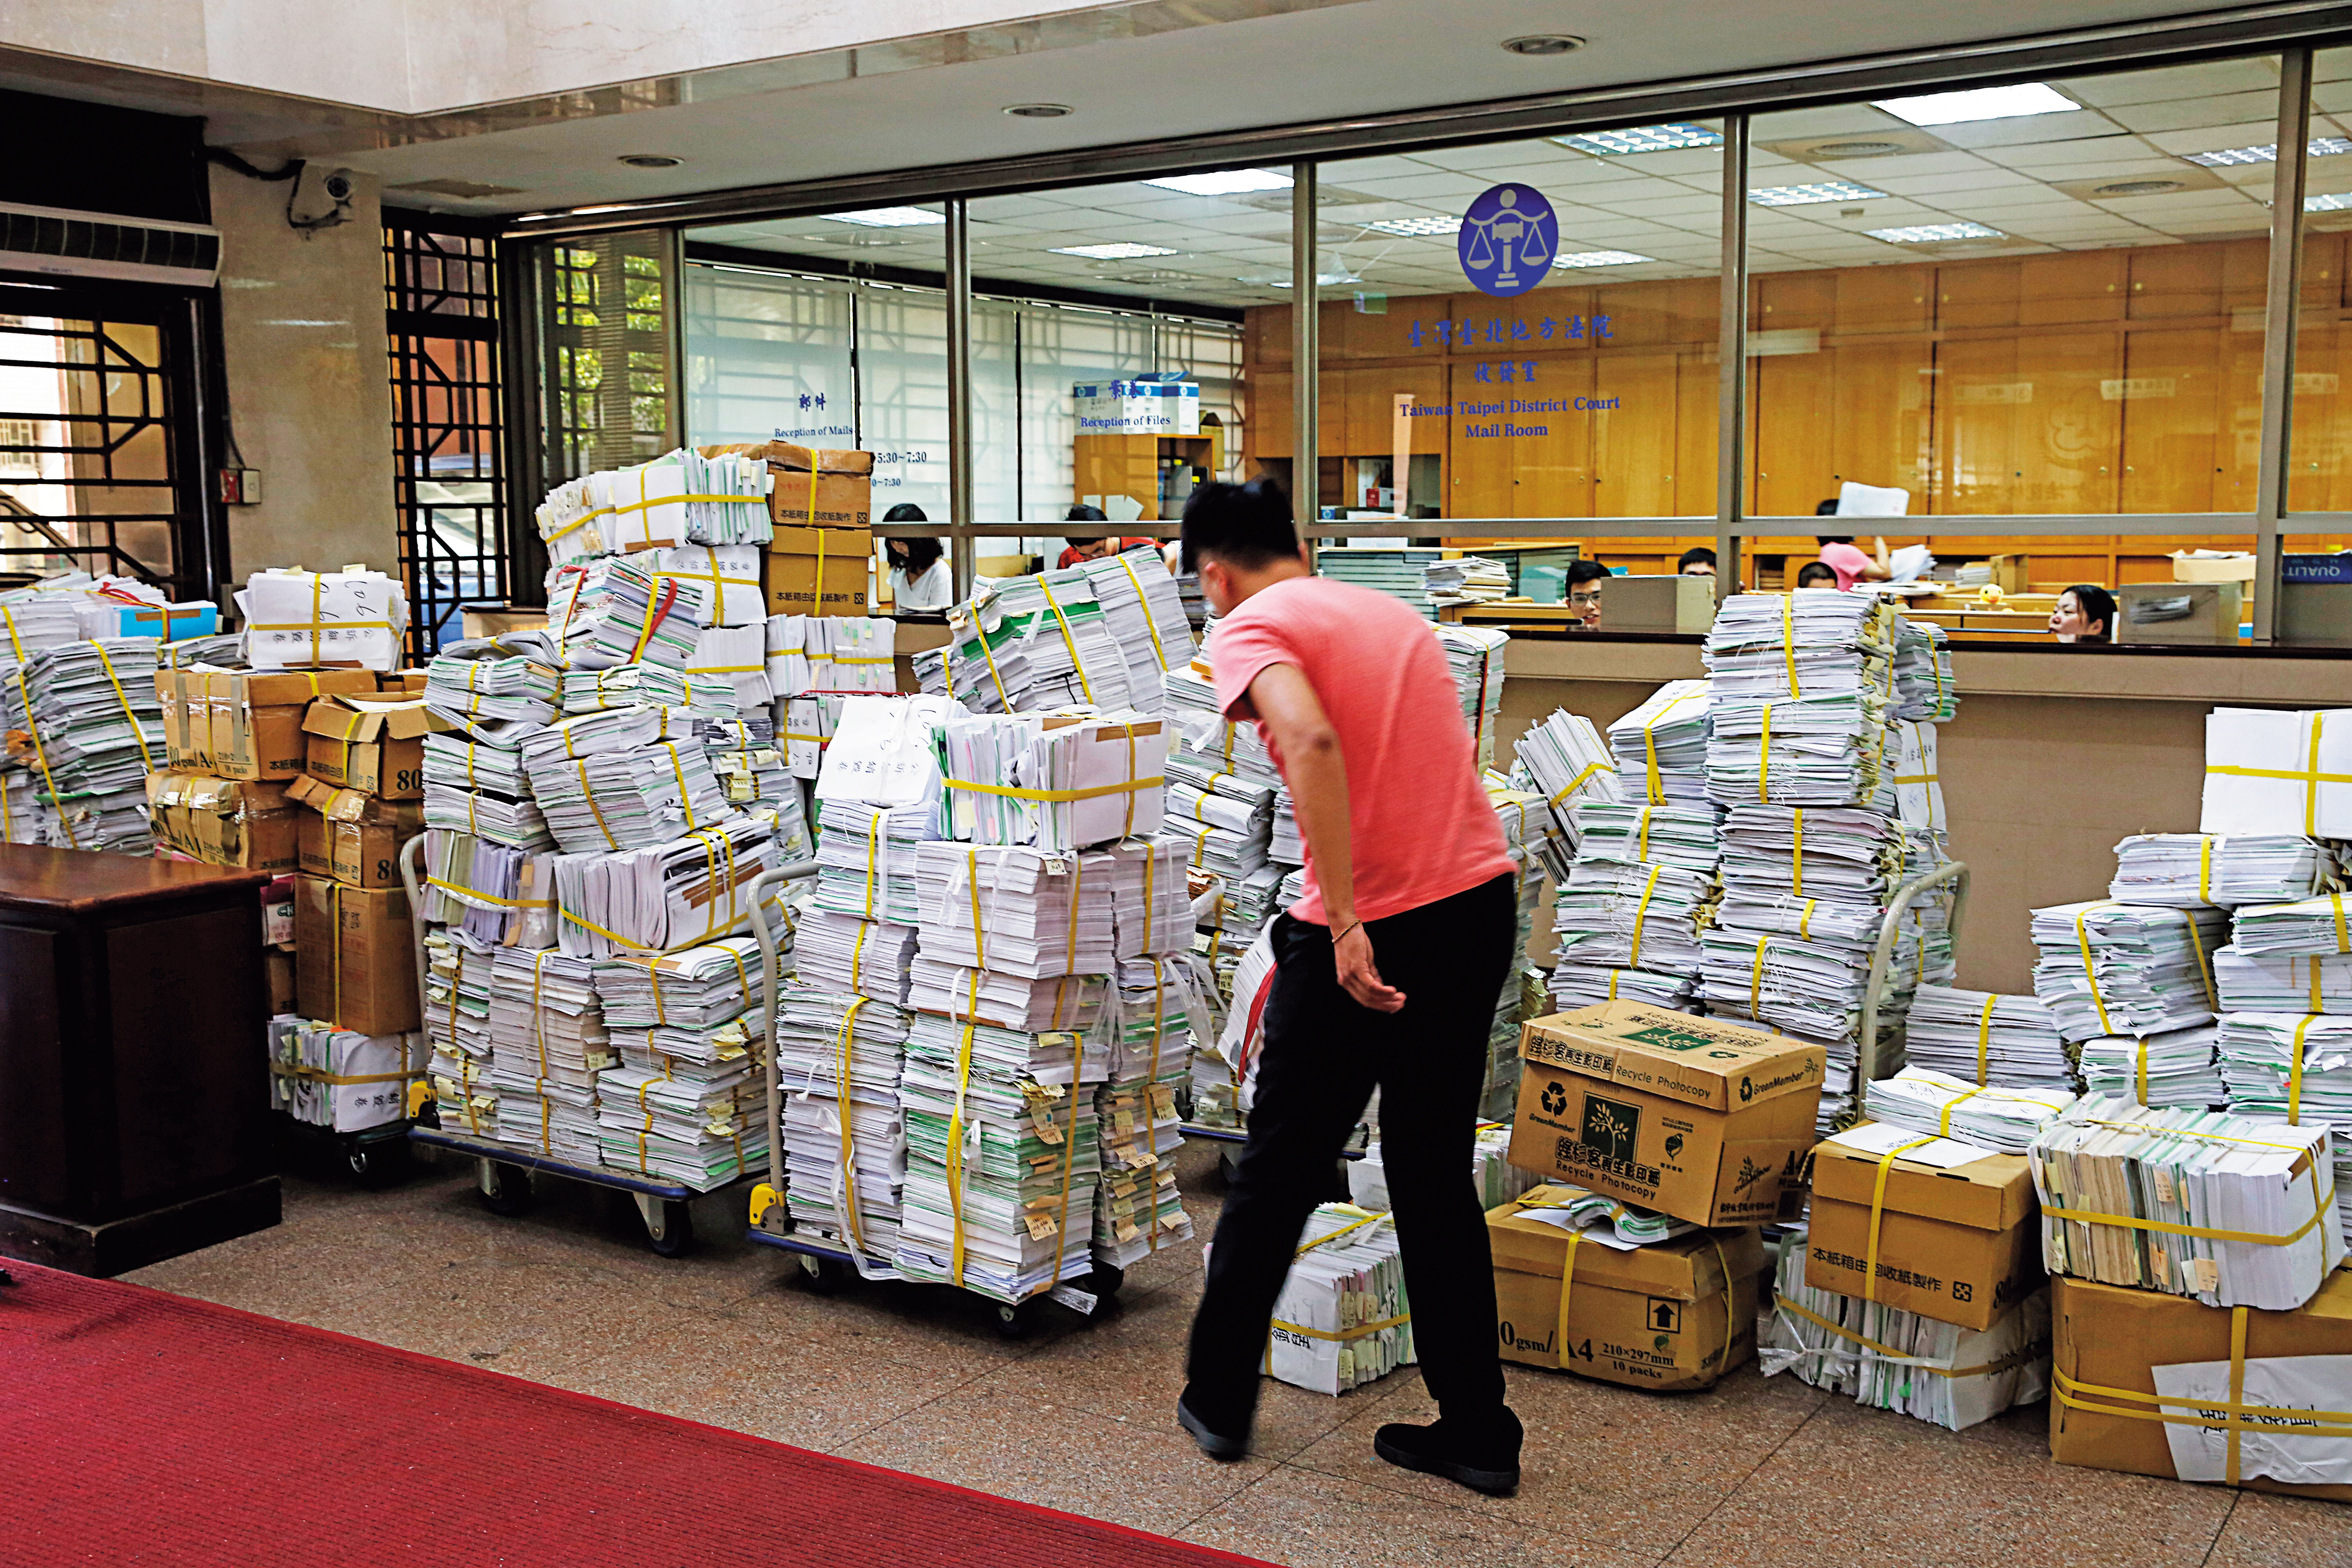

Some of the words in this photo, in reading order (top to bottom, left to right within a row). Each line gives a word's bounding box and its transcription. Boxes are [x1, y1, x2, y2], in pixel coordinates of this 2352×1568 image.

[1408, 315, 1613, 347] 臺灣臺北地方法院
[1474, 360, 1539, 383] 收發室
[799, 392, 826, 412] 郵件
[1400, 403, 1453, 417] Taiwan
[1458, 400, 1504, 417] Taipei
[1510, 399, 1567, 413] District
[1574, 396, 1620, 410] Court
[775, 428, 815, 438] Reception
[818, 426, 827, 436] of
[829, 425, 853, 435] Mails
[1081, 417, 1130, 428] Reception
[1134, 416, 1143, 426] of
[1147, 415, 1171, 425] Files
[1466, 424, 1499, 438] Mail
[1505, 423, 1548, 437] Room
[2284, 566, 2341, 576] QUALIT
[397, 769, 422, 791] 80
[1616, 1065, 1652, 1084] Recycle
[1657, 1076, 1711, 1100] Photocopy
[1753, 1071, 1804, 1096] GreenMember
[1556, 1161, 1595, 1181] Recycle
[1601, 1174, 1656, 1200] Photocopy
[1813, 1247, 1942, 1292] 本紙箱由回收紙製作
[1612, 1360, 1626, 1371] 10
[1629, 1364, 1662, 1379] packs
